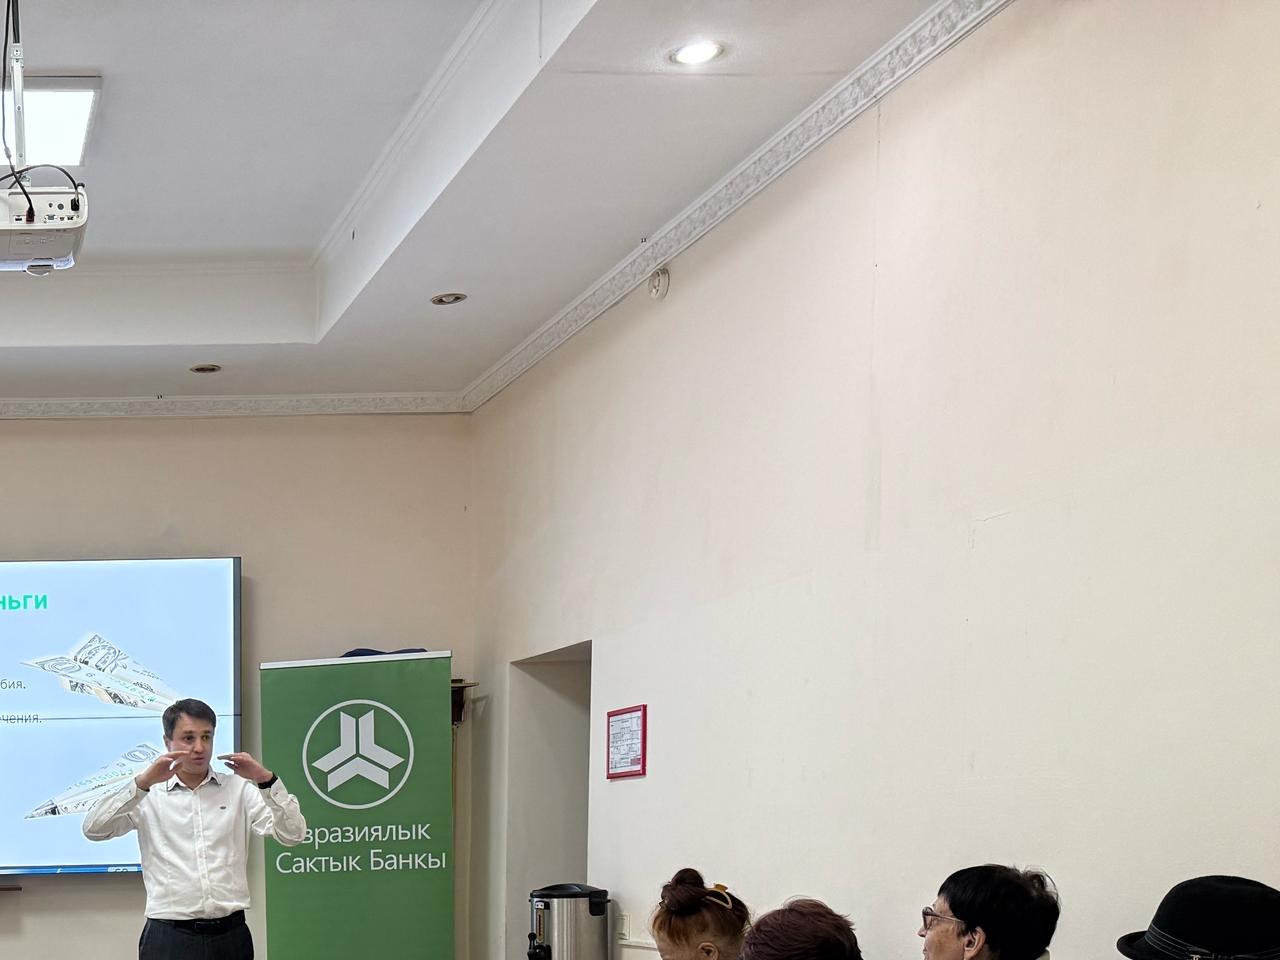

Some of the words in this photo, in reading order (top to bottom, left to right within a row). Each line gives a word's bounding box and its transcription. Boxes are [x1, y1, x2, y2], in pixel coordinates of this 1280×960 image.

[302, 823, 431, 850] вразиялык
[276, 852, 362, 874] Сактык
[370, 849, 446, 871] Банкы
